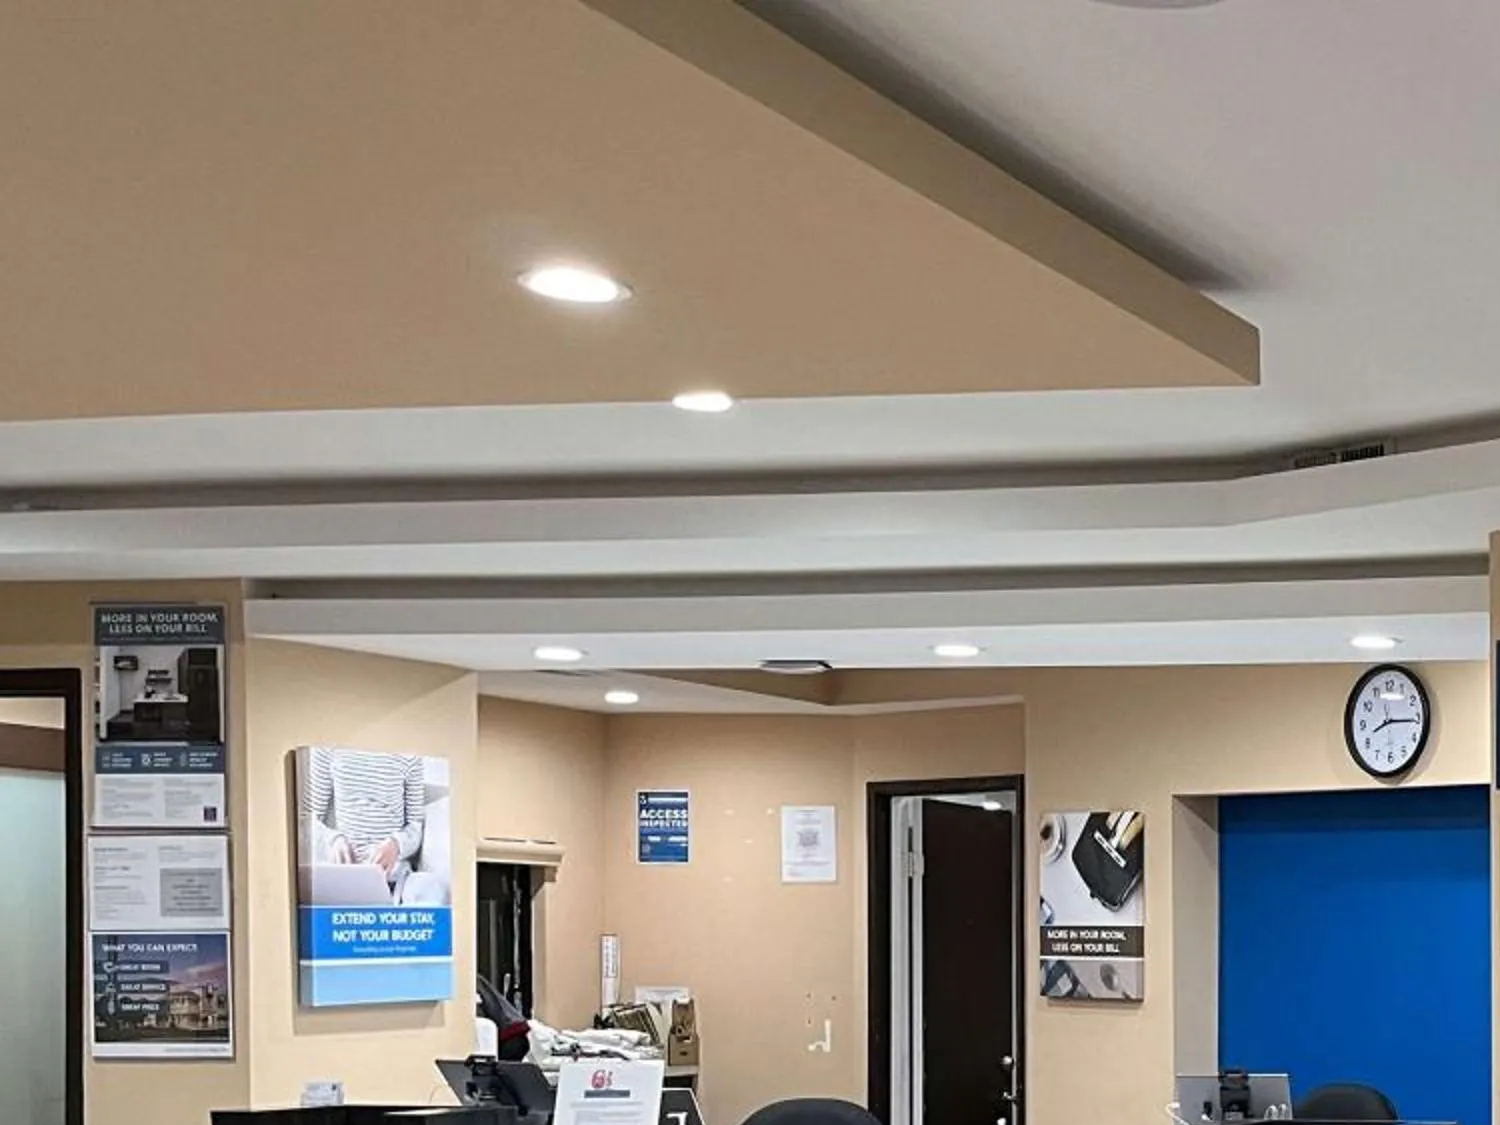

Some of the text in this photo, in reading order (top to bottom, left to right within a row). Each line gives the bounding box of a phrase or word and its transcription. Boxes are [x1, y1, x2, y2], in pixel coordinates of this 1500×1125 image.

[150, 612, 180, 623] YOUR
[135, 624, 153, 633] ON
[155, 624, 183, 634] YOUR
[1385, 680, 1395, 692] 12
[1372, 687, 1380, 698] 11
[1409, 694, 1417, 707] 2
[1363, 700, 1373, 713] 10
[1360, 719, 1367, 731] 9
[1374, 749, 1381, 760] 7
[1387, 752, 1394, 764] 6
[640, 809, 687, 819] ACCESS
[332, 911, 377, 925] EXTEND
[379, 911, 408, 924] YOUR
[332, 929, 357, 942] NOT
[360, 929, 389, 942] YOUR
[1080, 929, 1099, 939] YOUR
[102, 943, 125, 952] WHAT
[127, 943, 145, 952] YOU
[146, 943, 164, 953] CAN
[1083, 943, 1104, 953] YOUR
